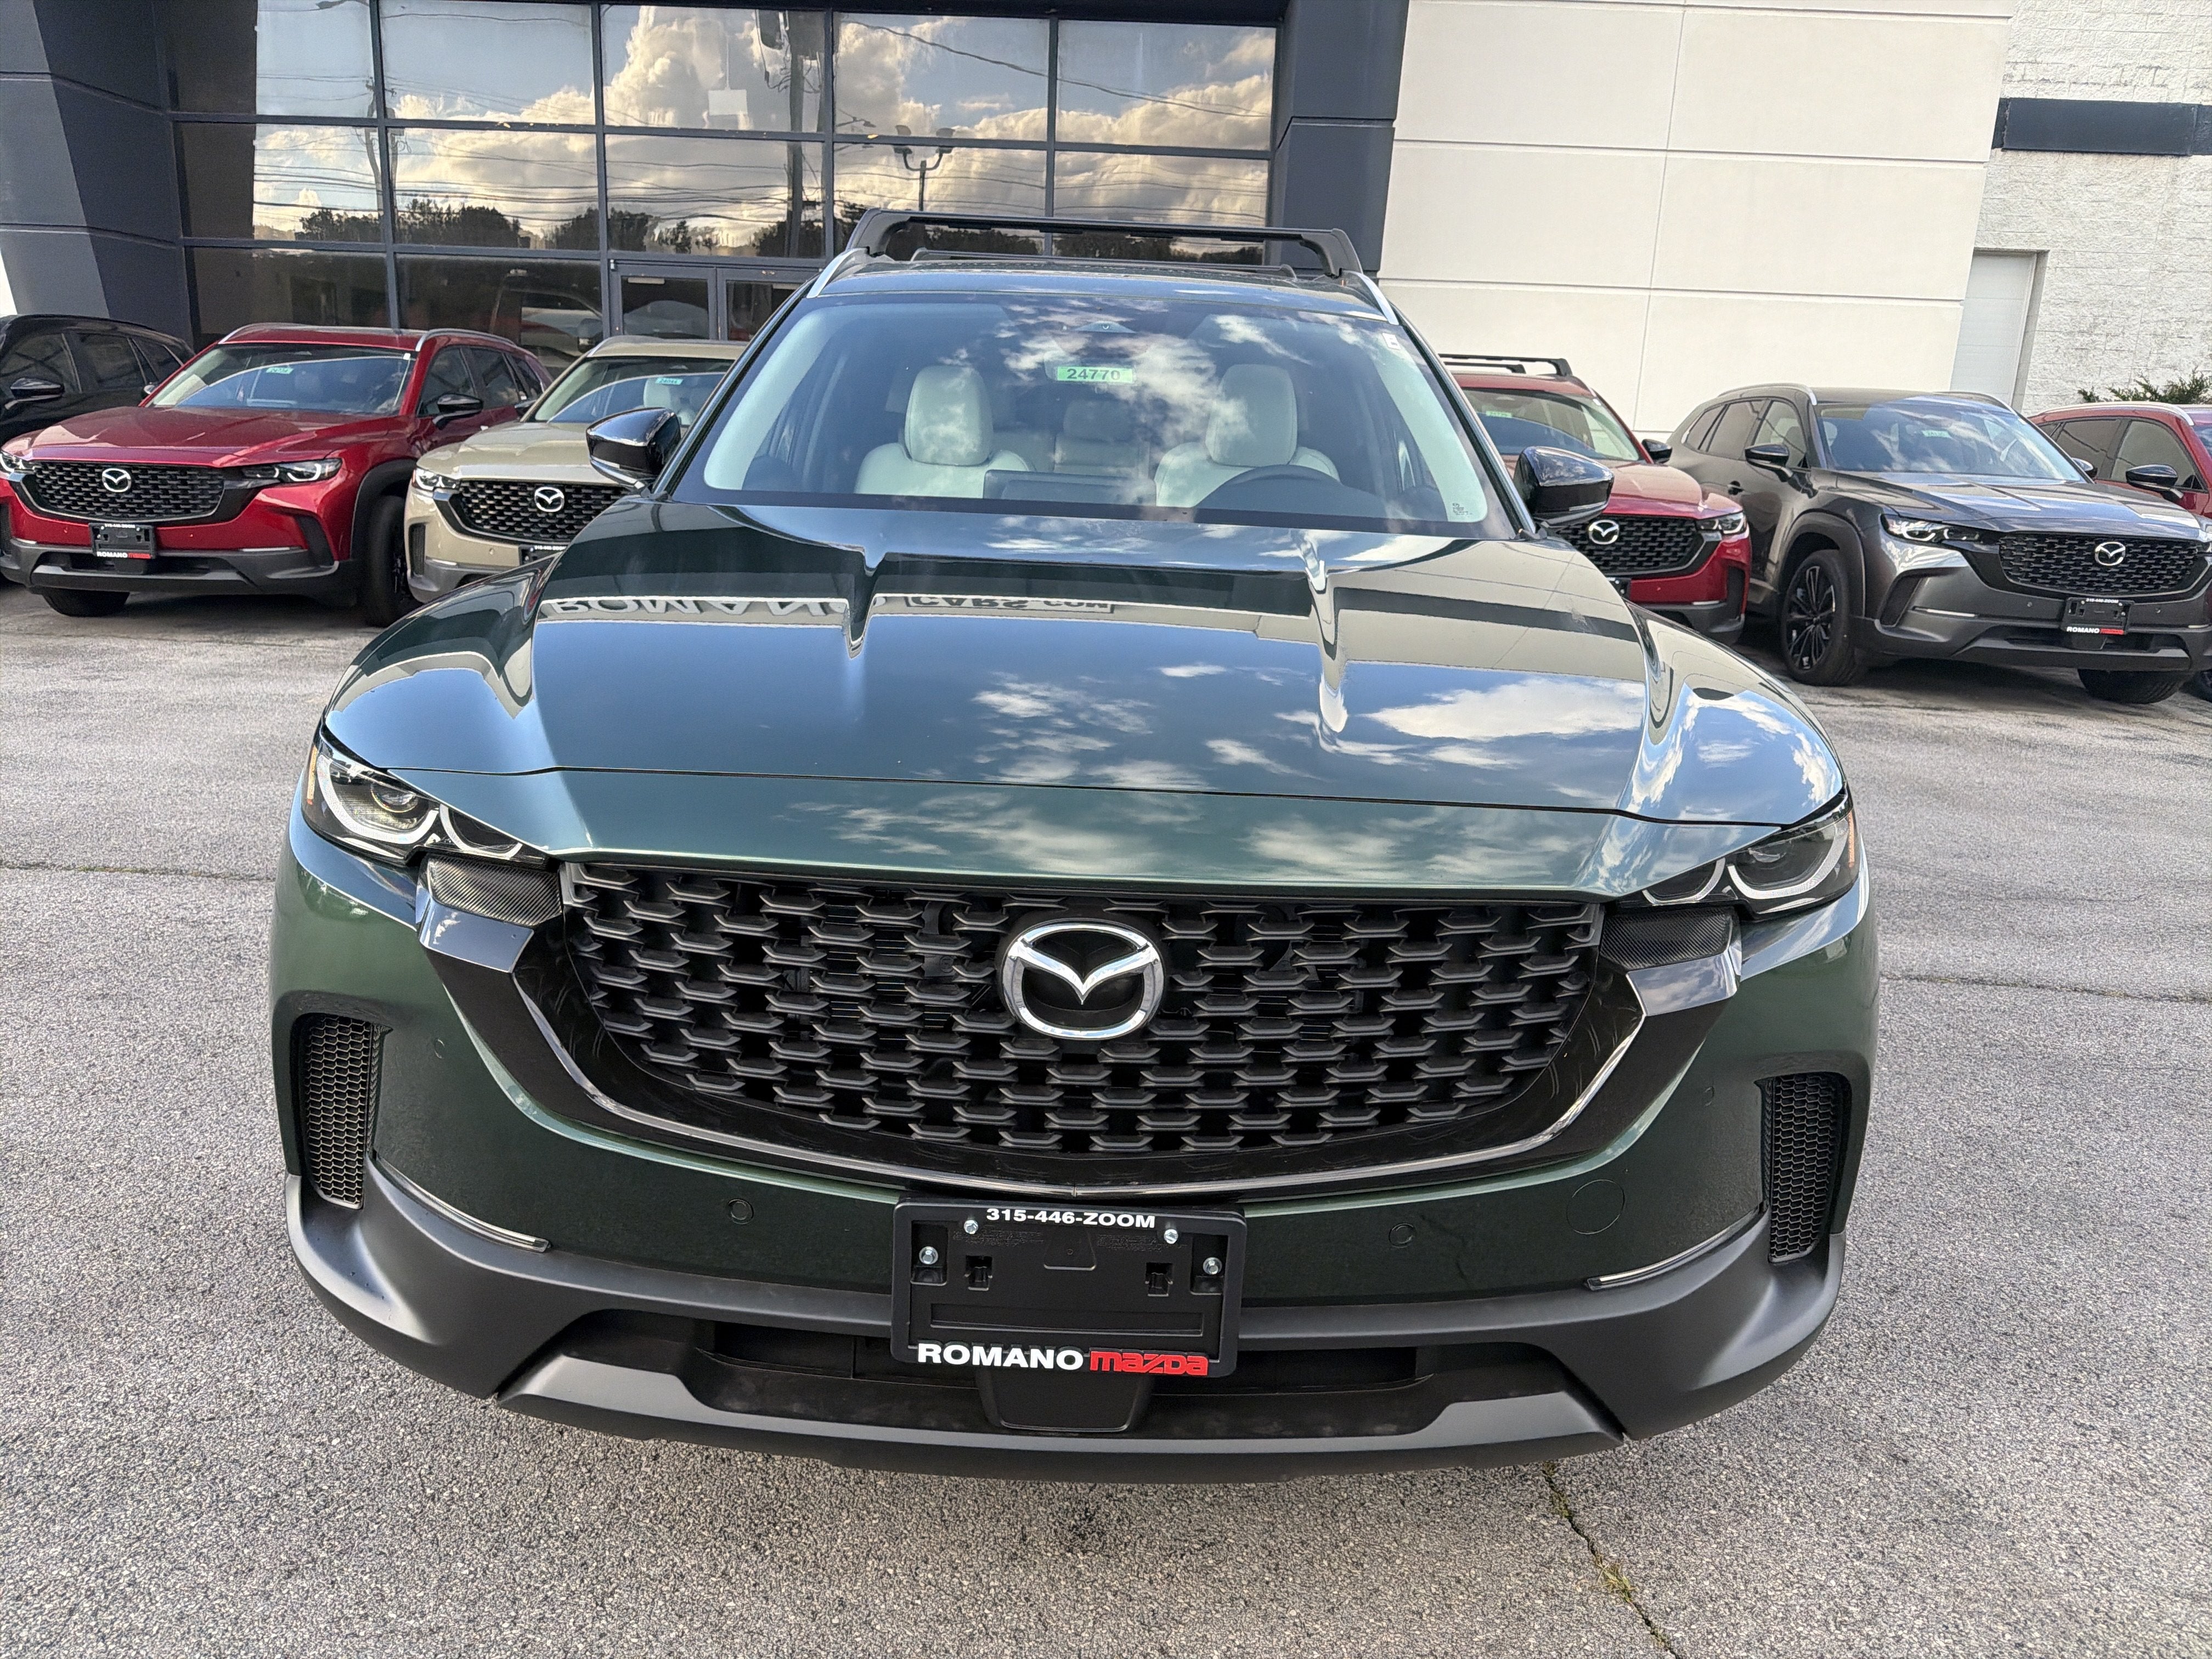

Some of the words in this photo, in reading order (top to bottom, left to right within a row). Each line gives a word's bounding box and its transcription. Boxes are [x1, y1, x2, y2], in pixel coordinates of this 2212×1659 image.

[1066, 368, 1121, 381] 24770
[986, 1207, 1155, 1228] 315-446-ZOOM
[917, 1342, 1084, 1370] ROMANO
